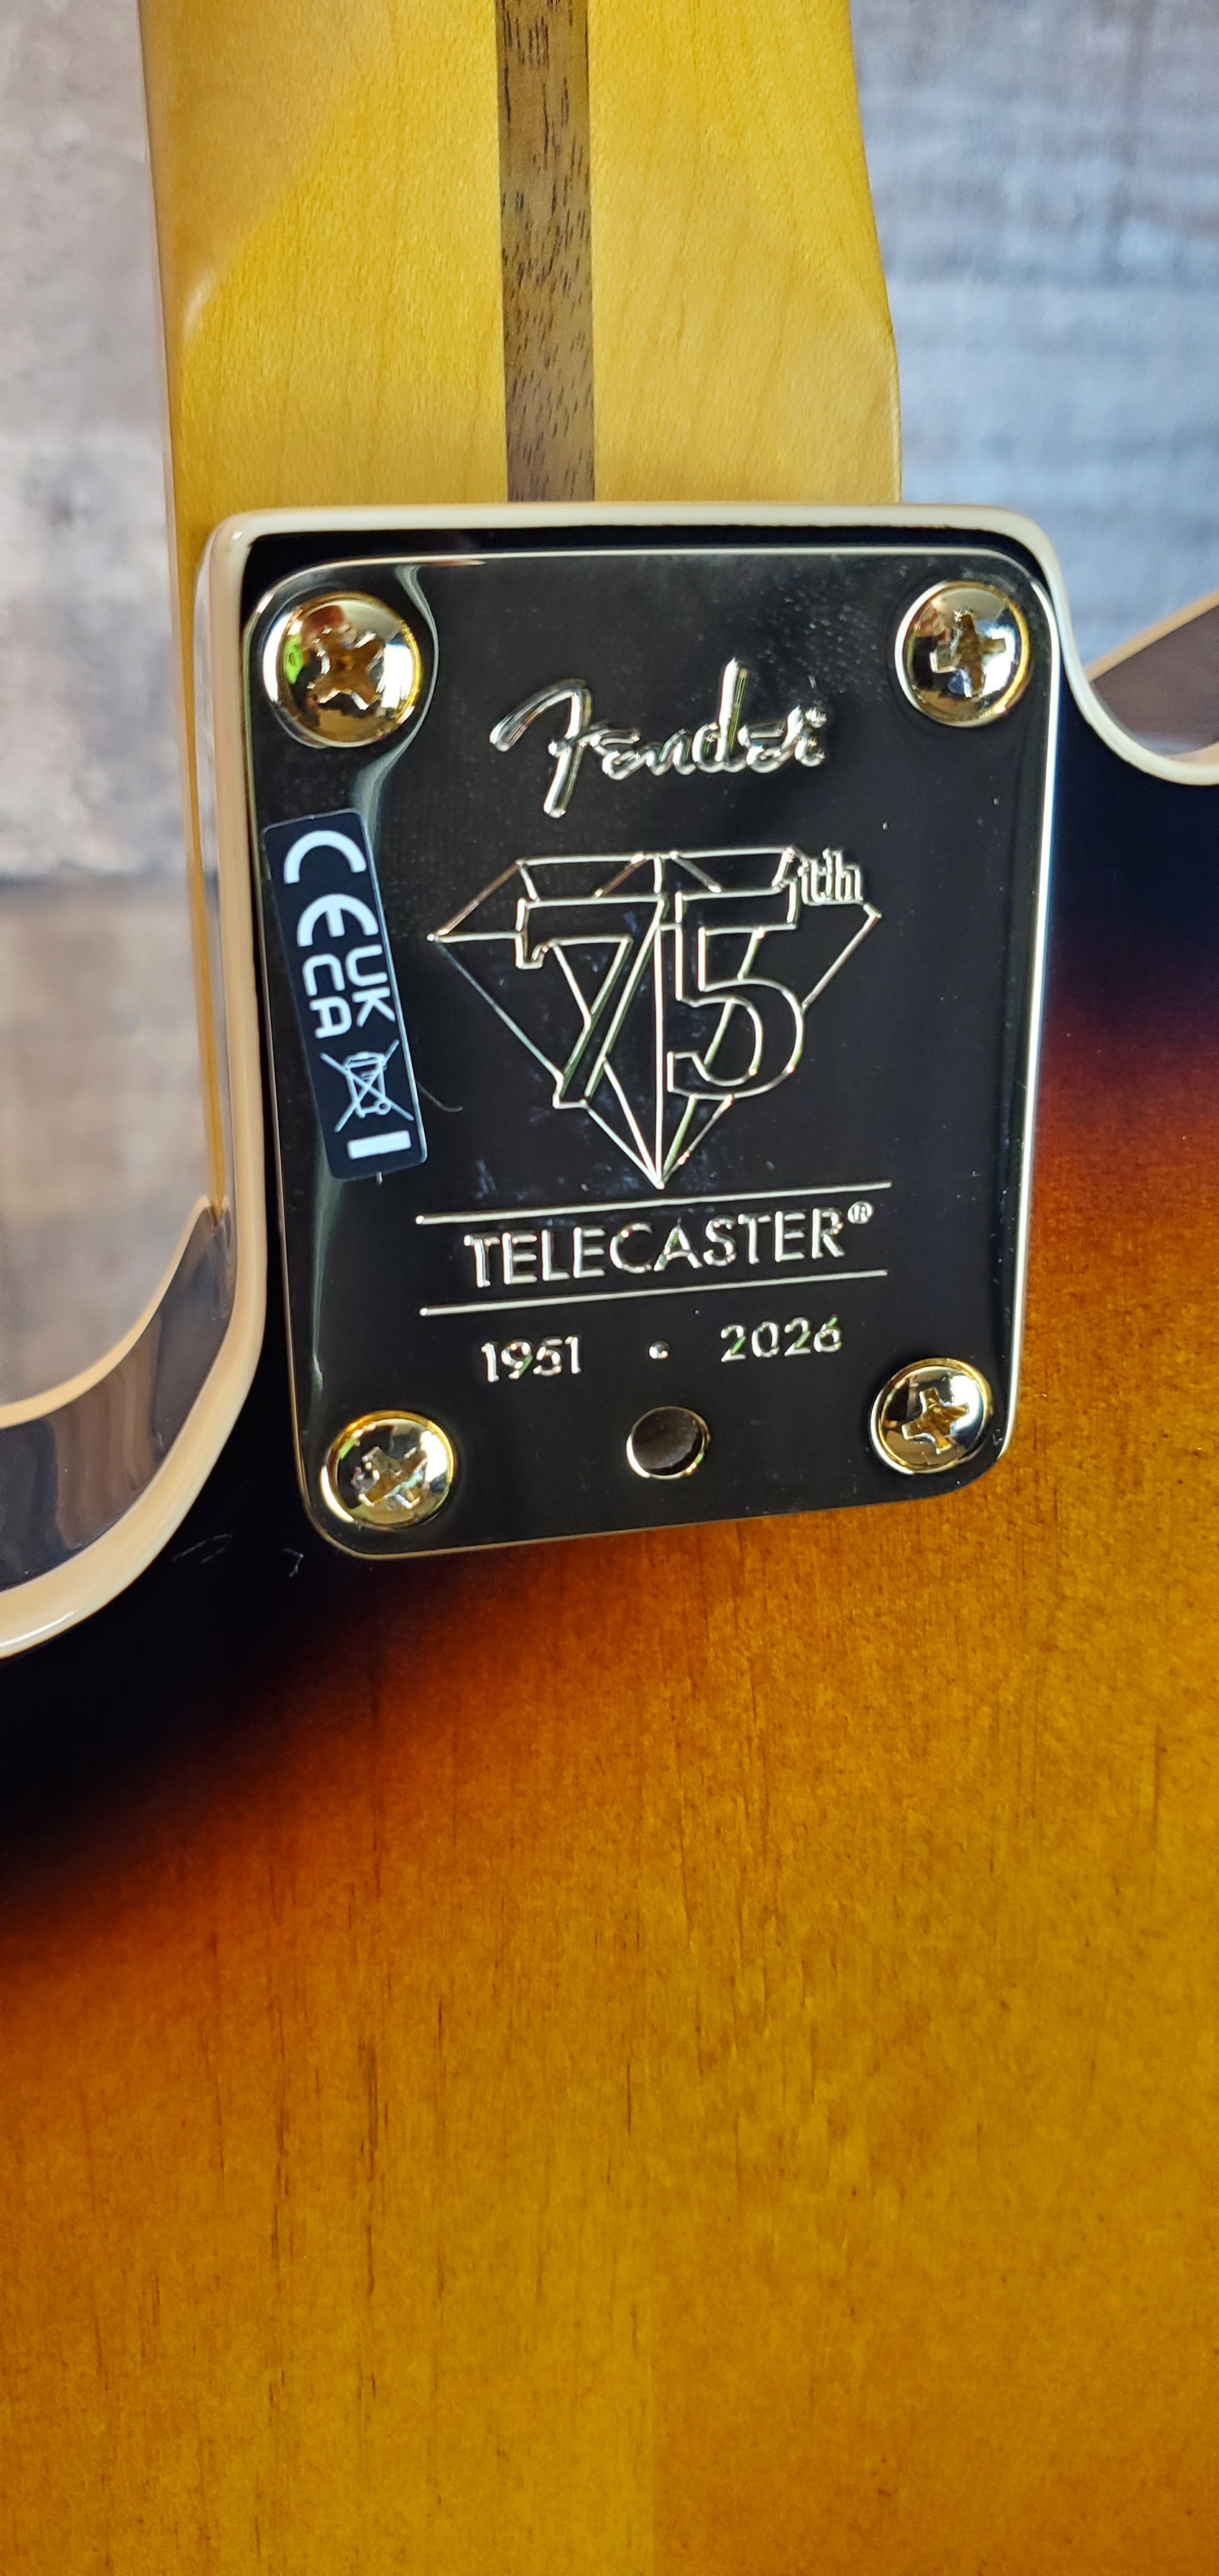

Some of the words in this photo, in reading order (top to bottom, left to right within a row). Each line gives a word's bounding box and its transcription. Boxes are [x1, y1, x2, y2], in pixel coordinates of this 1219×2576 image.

[489, 657, 828, 818] Fender
[284, 830, 379, 947] CE
[302, 953, 353, 1039] CA
[345, 944, 395, 1028] UK
[481, 1335, 583, 1383] 1951
[720, 1314, 844, 1363] 2026
